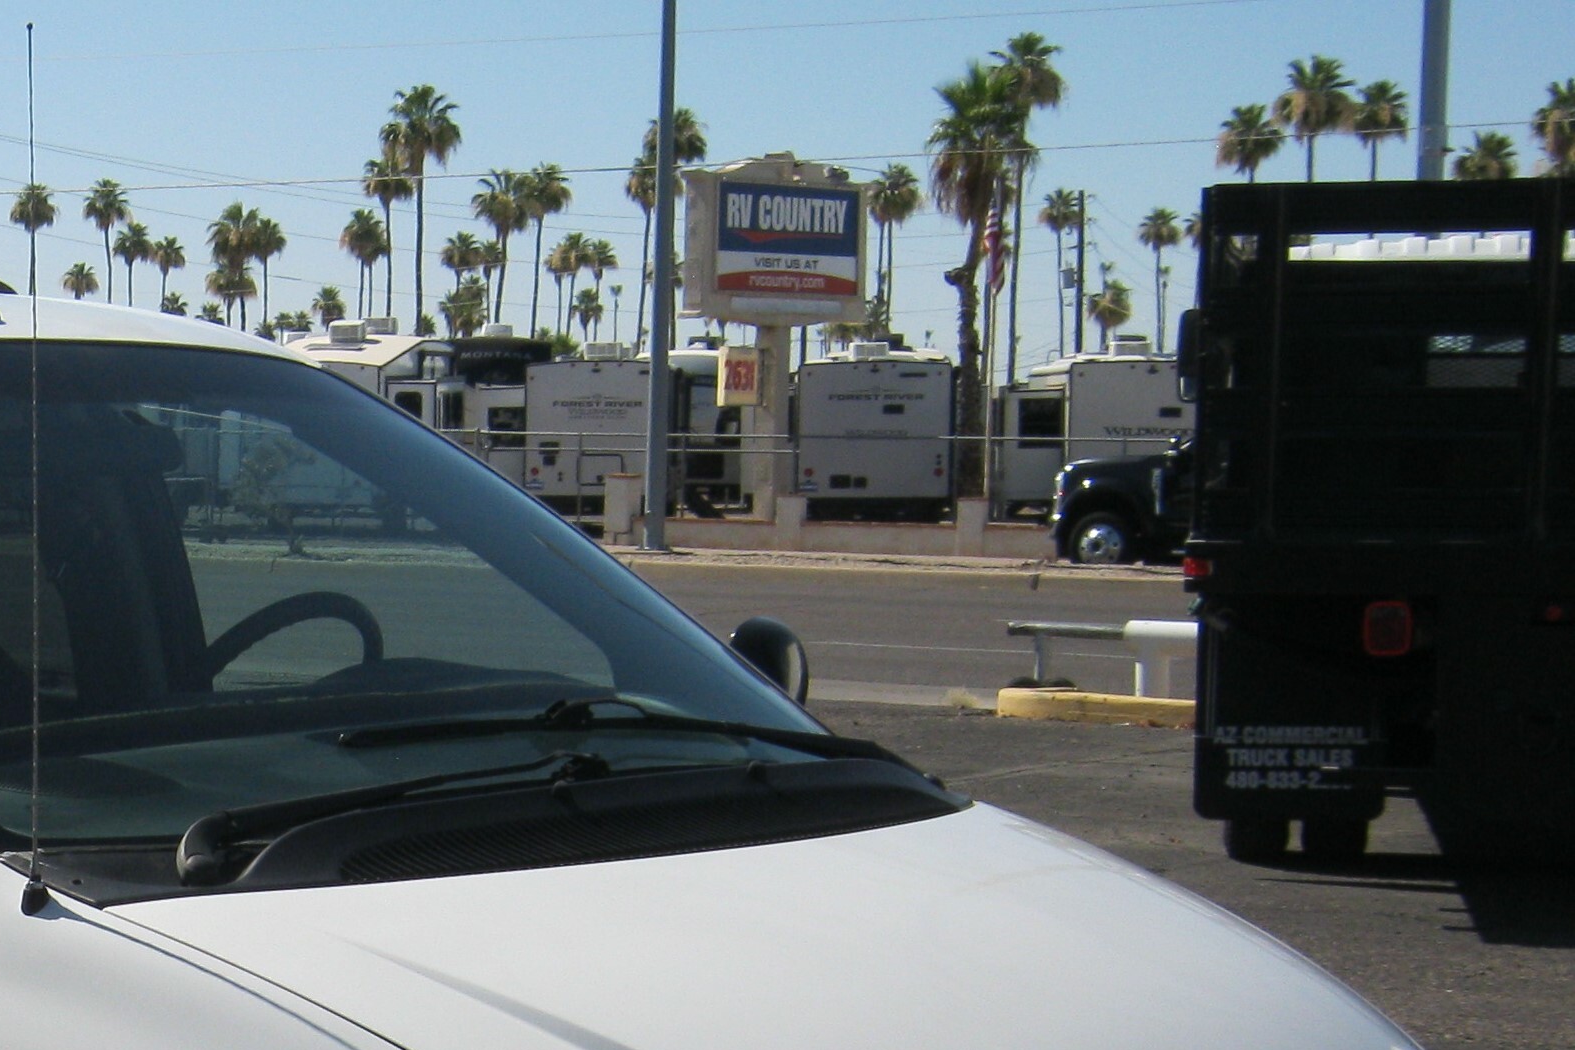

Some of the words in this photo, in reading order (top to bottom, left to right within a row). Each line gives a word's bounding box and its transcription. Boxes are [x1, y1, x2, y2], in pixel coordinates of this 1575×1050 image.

[727, 193, 753, 229] RV
[758, 195, 847, 234] COUNTRY
[754, 257, 782, 269] VISIT
[785, 259, 800, 269] US
[804, 260, 819, 270] AT
[749, 275, 825, 291] rvcountry.com
[552, 400, 601, 408] FOREST
[604, 400, 643, 408] RIVER
[828, 393, 880, 401] FOREST
[883, 393, 924, 401] RIVER
[1213, 726, 1238, 744] AZ
[1242, 726, 1368, 744] COMMERCIAL
[1226, 748, 1289, 767] TRUCK
[1294, 749, 1353, 768] SALES
